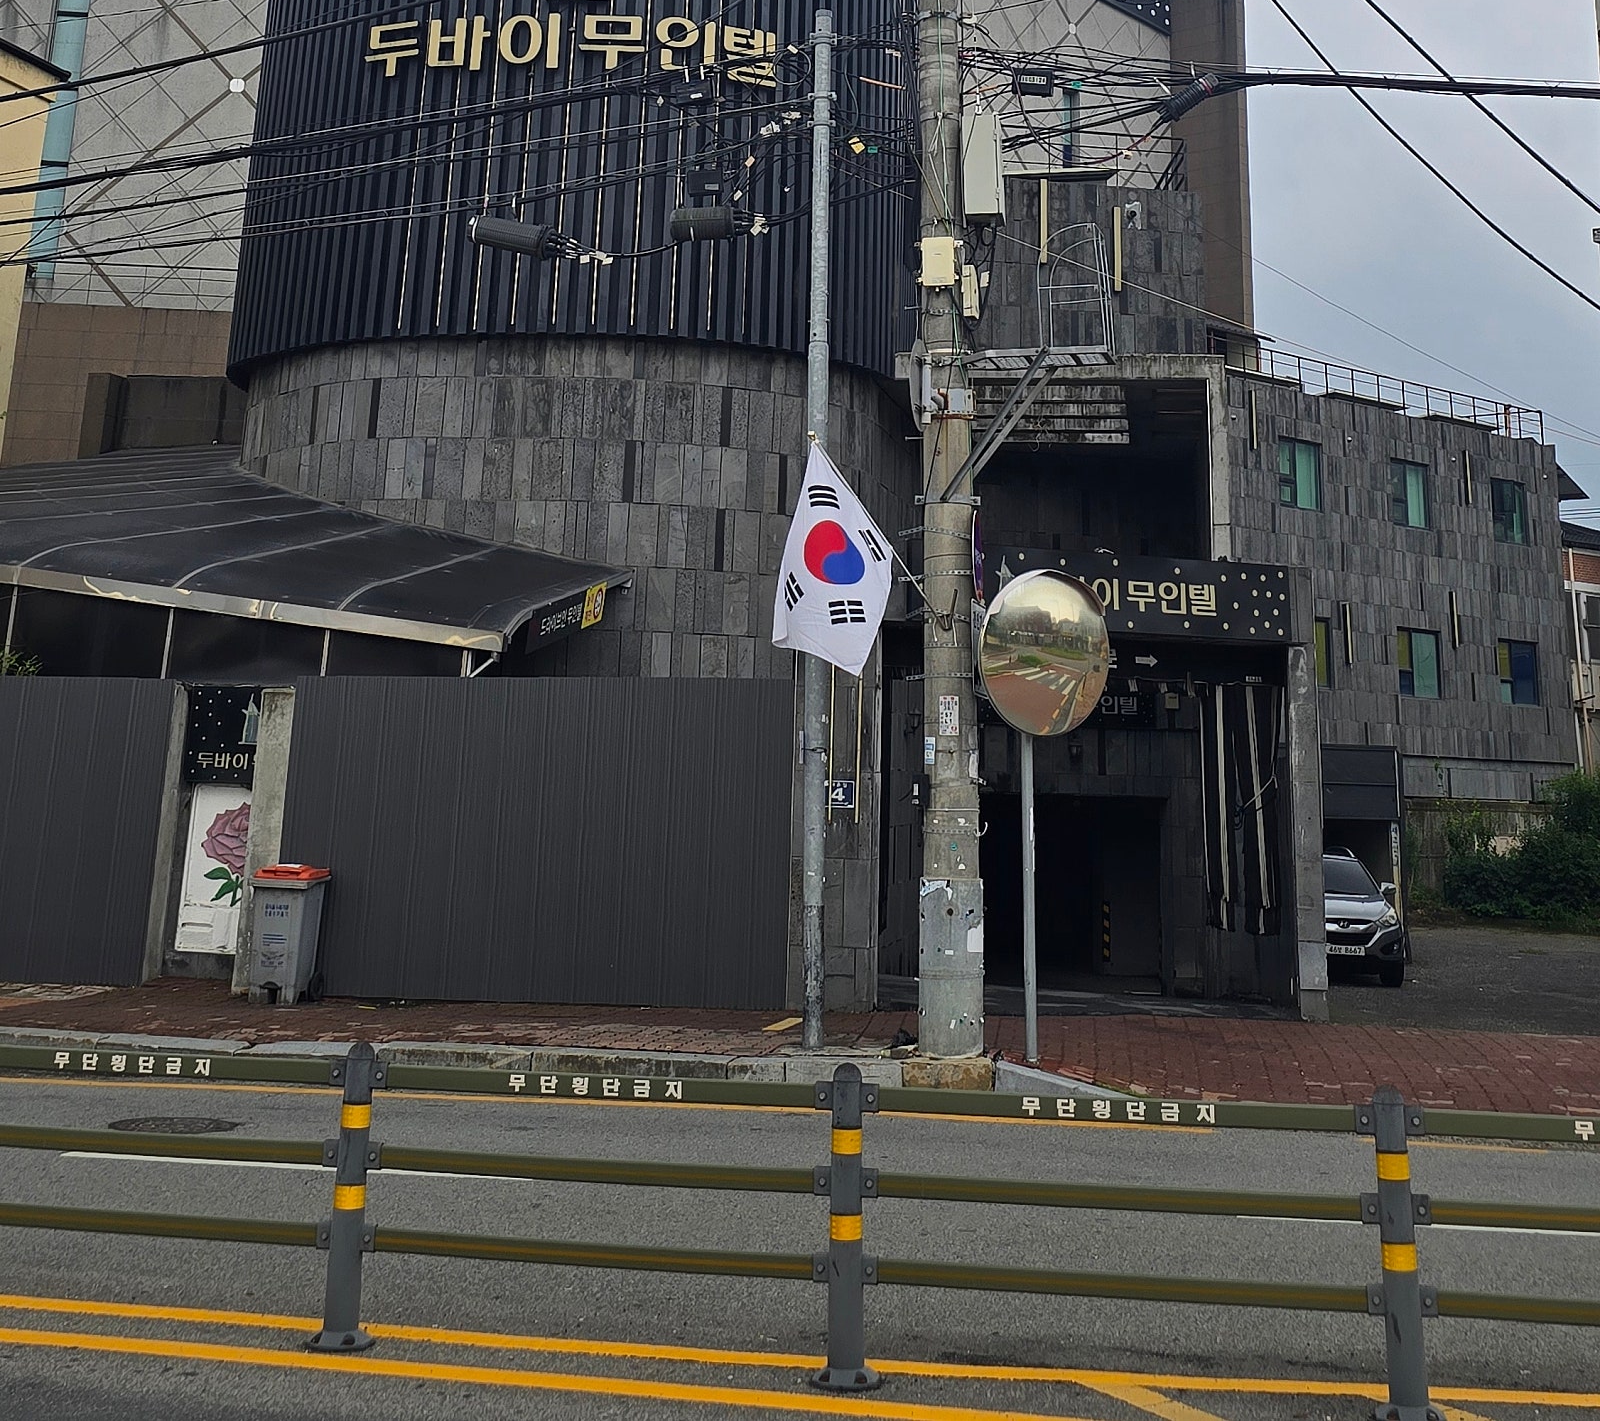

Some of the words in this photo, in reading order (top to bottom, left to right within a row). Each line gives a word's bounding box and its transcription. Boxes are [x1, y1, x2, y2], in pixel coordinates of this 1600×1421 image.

[1126, 580, 1217, 616] 무인텔
[1097, 695, 1138, 715] 인텔
[196, 752, 249, 770] 두바이
